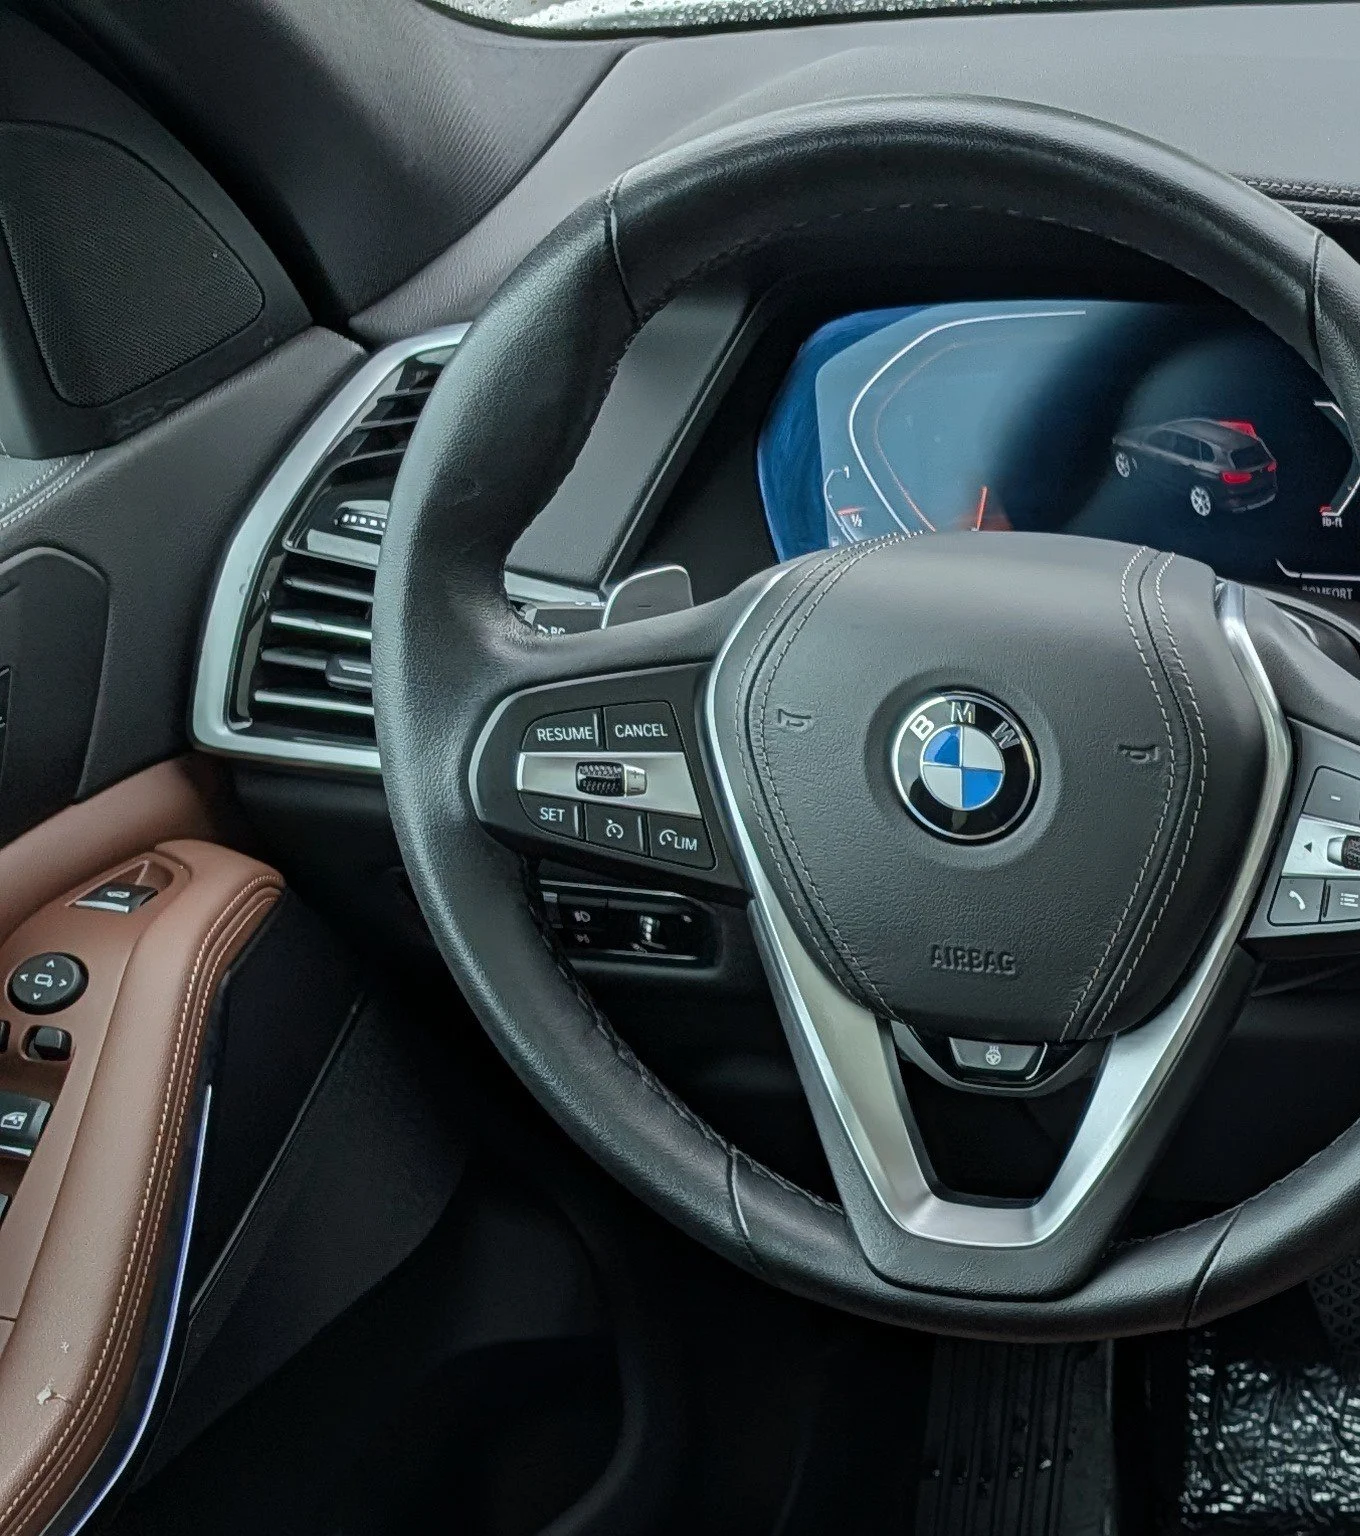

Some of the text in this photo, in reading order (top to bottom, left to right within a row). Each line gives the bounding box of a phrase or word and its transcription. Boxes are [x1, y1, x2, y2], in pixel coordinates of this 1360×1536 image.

[536, 725, 593, 742] RESUME
[614, 722, 669, 740] CANCEL
[909, 701, 1021, 751] BMW
[539, 806, 566, 824] SET
[673, 836, 699, 852] LIM
[931, 944, 1017, 976] AIRBAG
